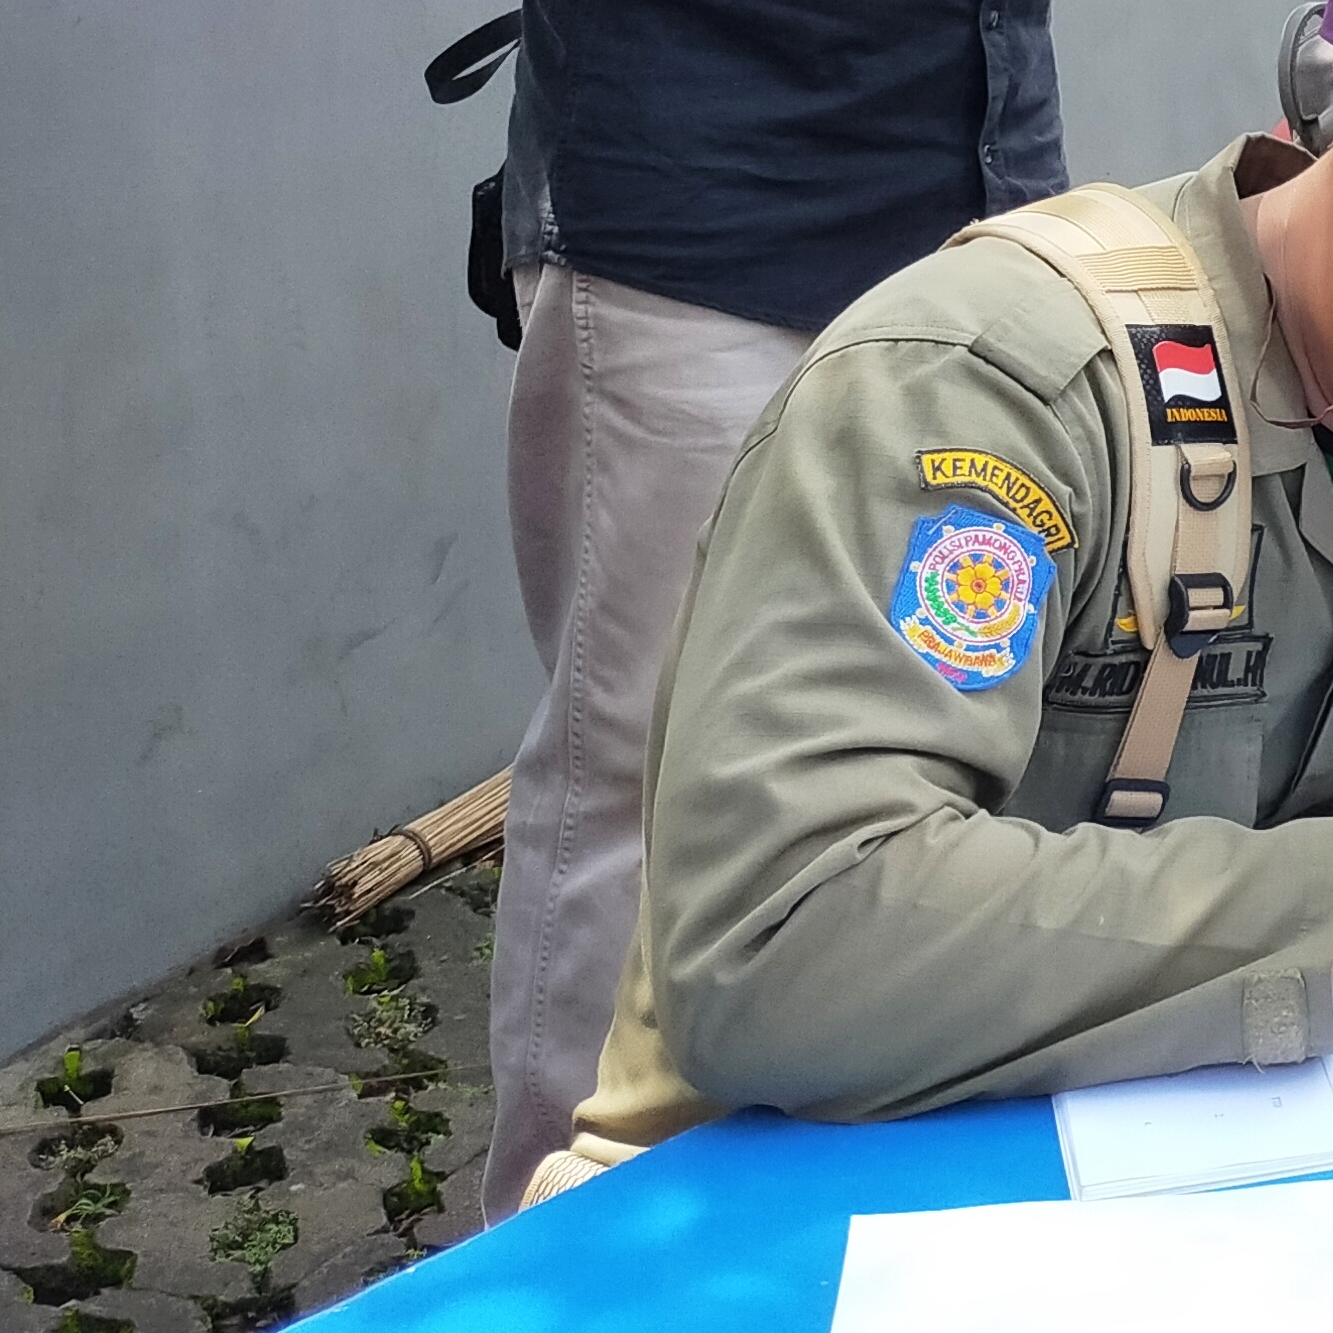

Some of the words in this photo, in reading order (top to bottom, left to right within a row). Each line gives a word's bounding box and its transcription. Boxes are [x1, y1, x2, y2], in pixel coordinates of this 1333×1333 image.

[1165, 407, 1228, 423] INDONESIA
[930, 457, 1067, 547] KEMENDAGRI
[928, 539, 964, 572] POLISI
